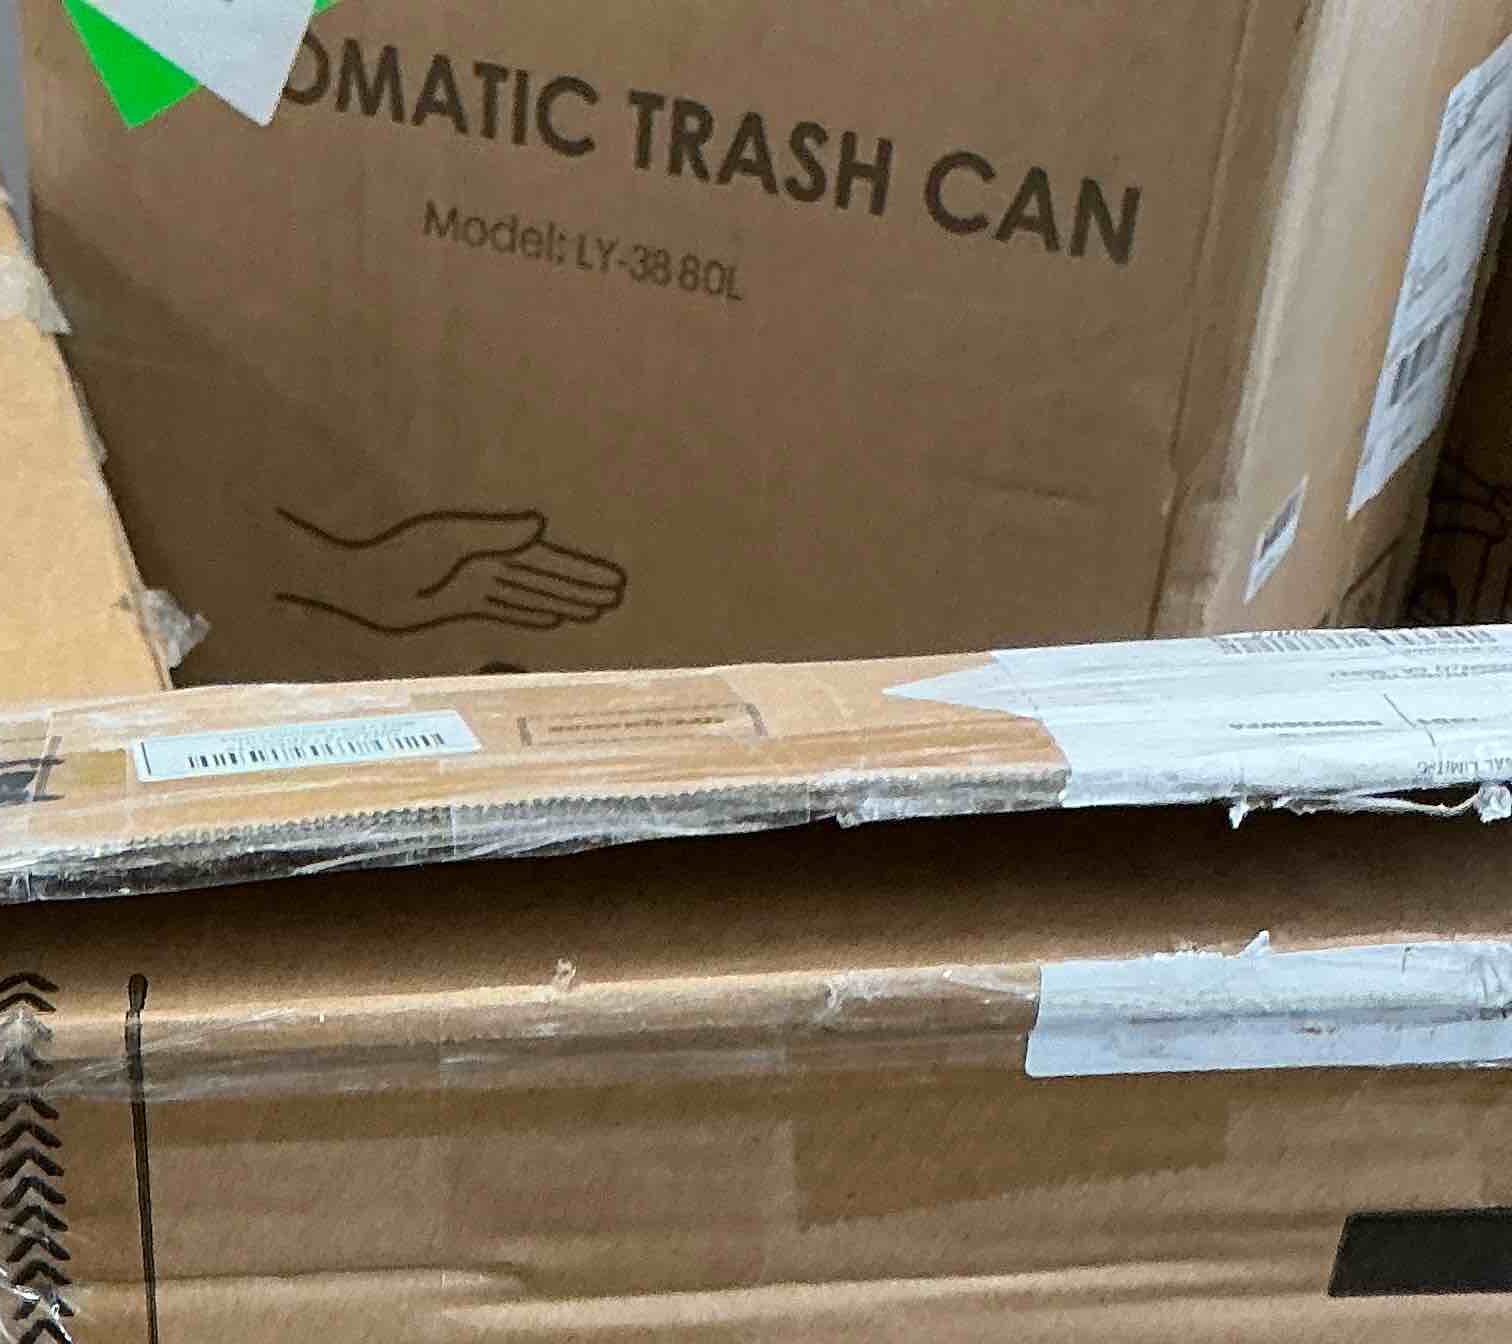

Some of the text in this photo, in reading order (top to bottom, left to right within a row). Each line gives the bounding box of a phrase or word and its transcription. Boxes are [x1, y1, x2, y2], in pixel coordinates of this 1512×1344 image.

[281, 31, 1144, 265] OMATIC TRASH CAN
[423, 200, 567, 267] Model:
